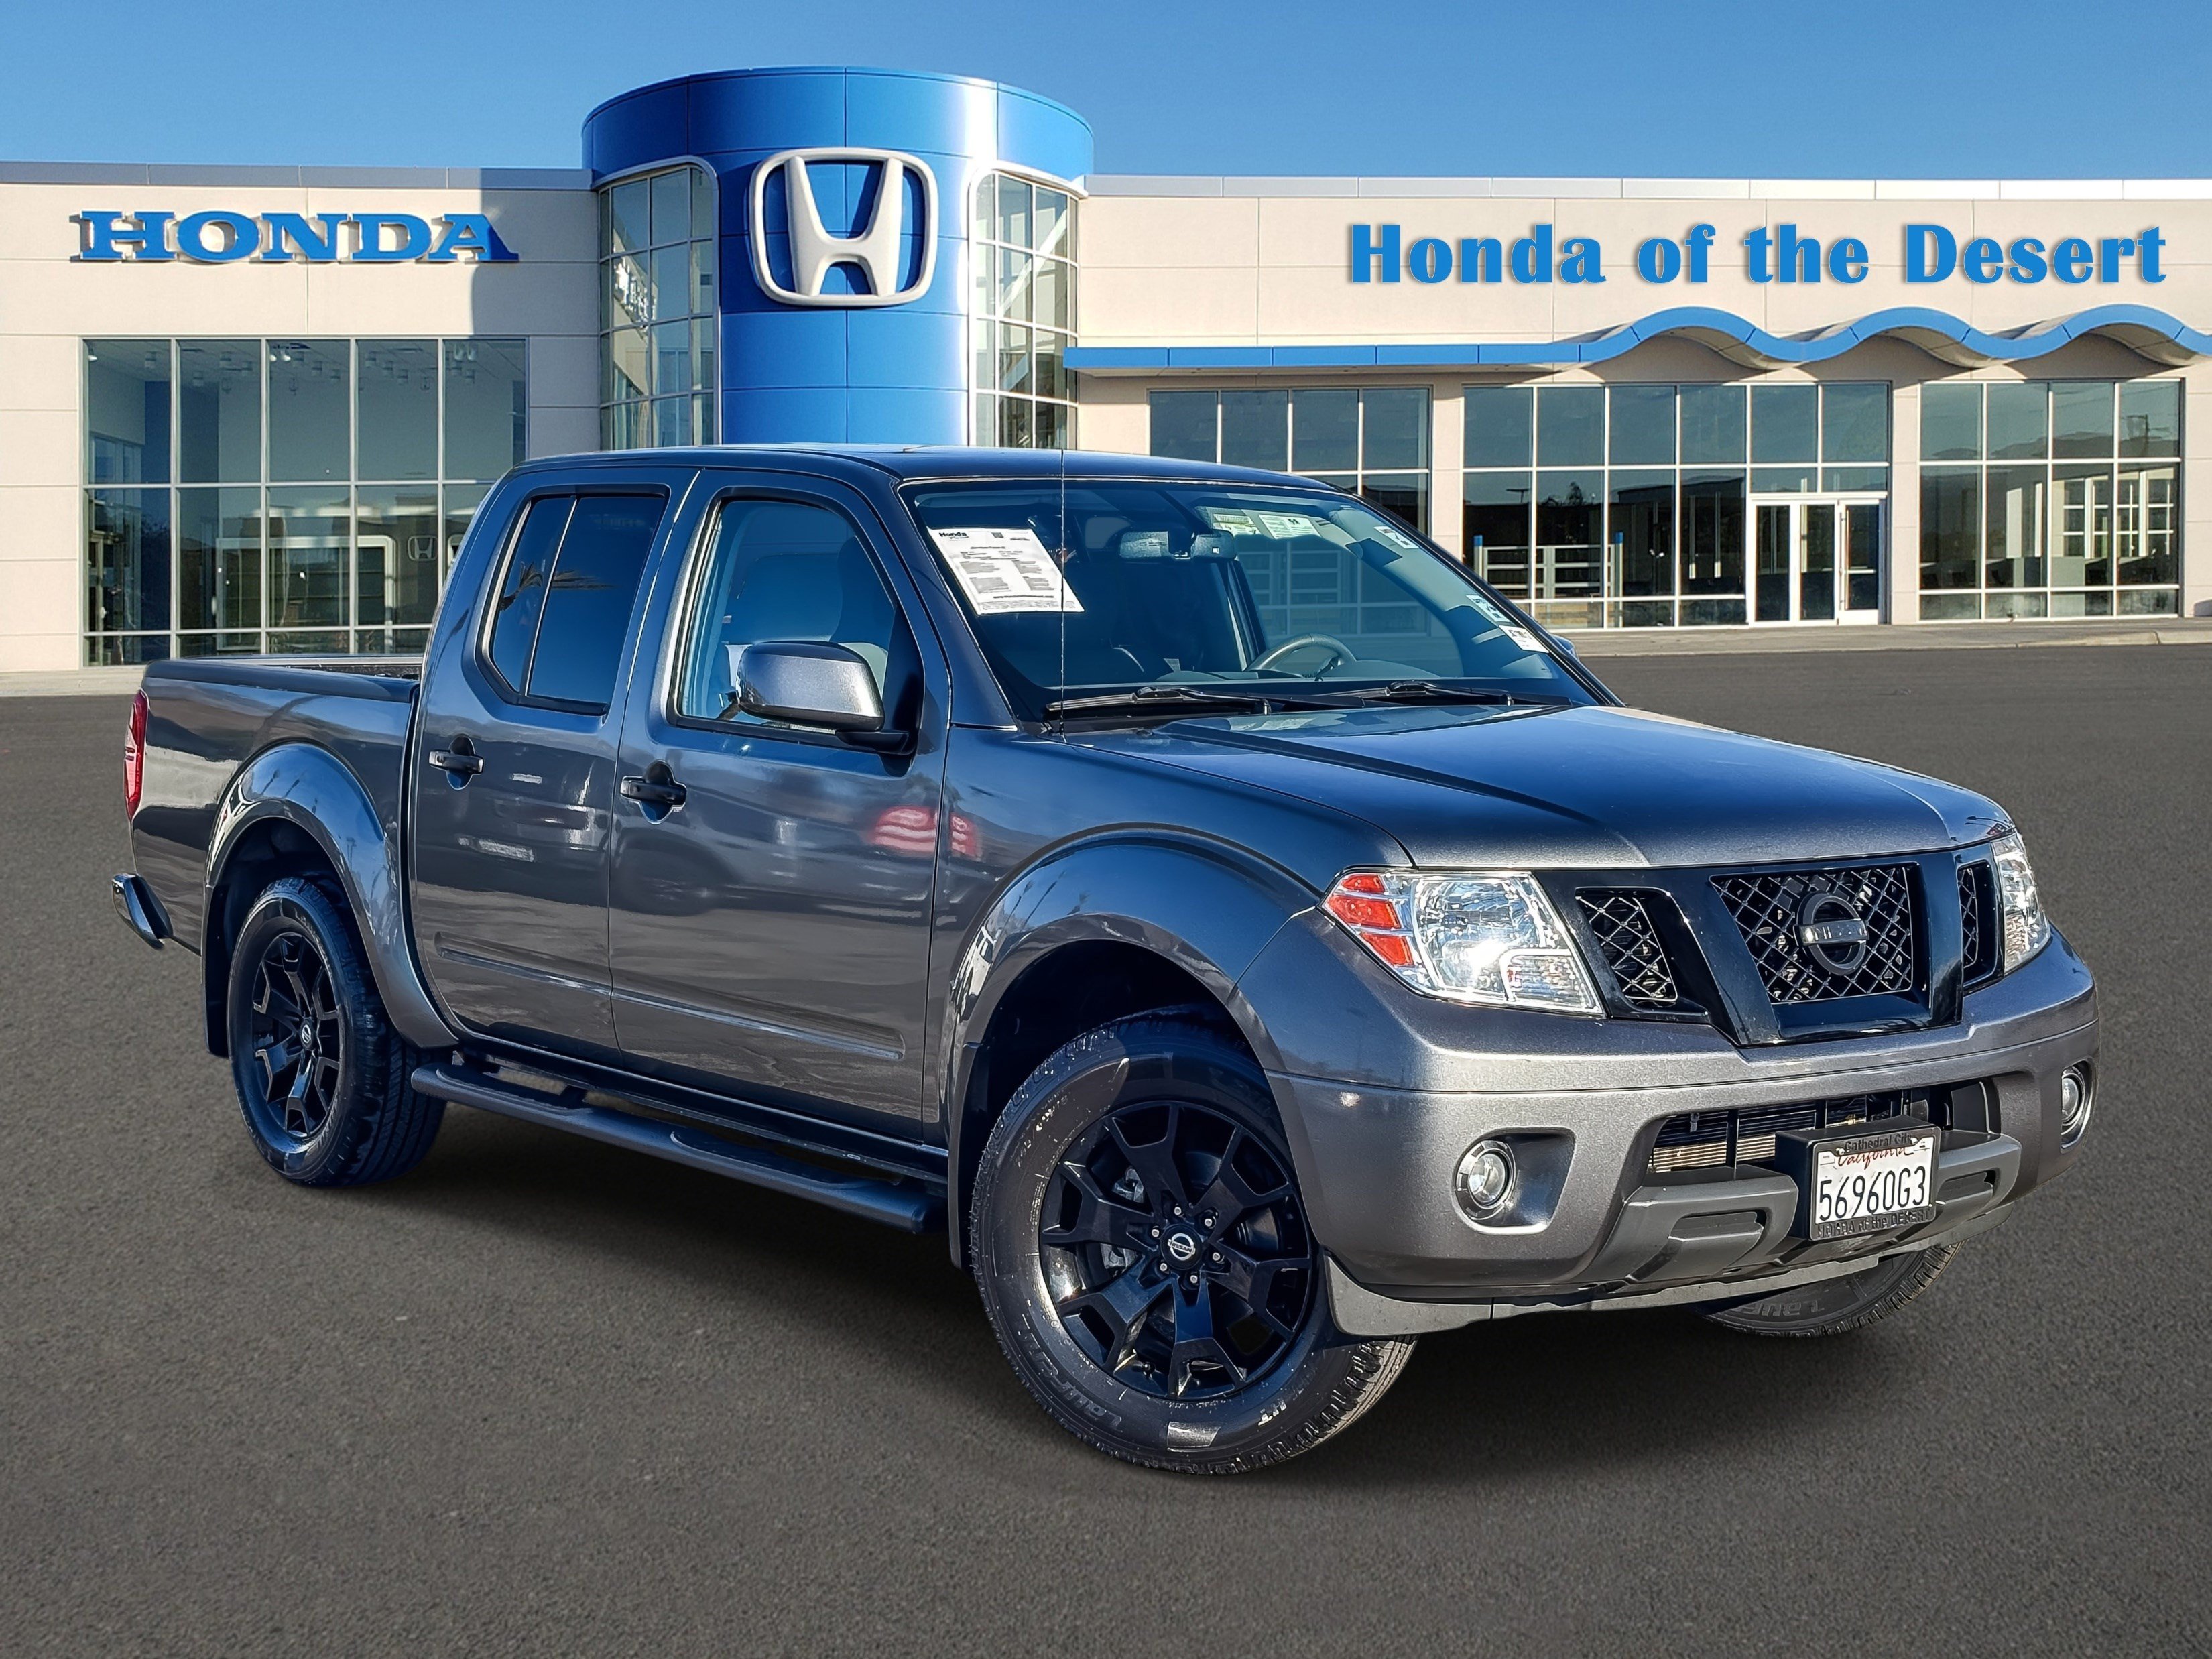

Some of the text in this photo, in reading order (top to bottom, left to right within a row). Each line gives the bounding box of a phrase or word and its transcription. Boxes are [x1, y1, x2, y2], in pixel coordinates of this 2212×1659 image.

[78, 210, 519, 262] HONDA
[1351, 223, 2166, 284] Honda of the Desert
[1844, 1135, 1892, 1152] Cathedral
[1894, 1133, 1913, 1146] City
[1819, 1166, 1926, 1221] 56960G3
